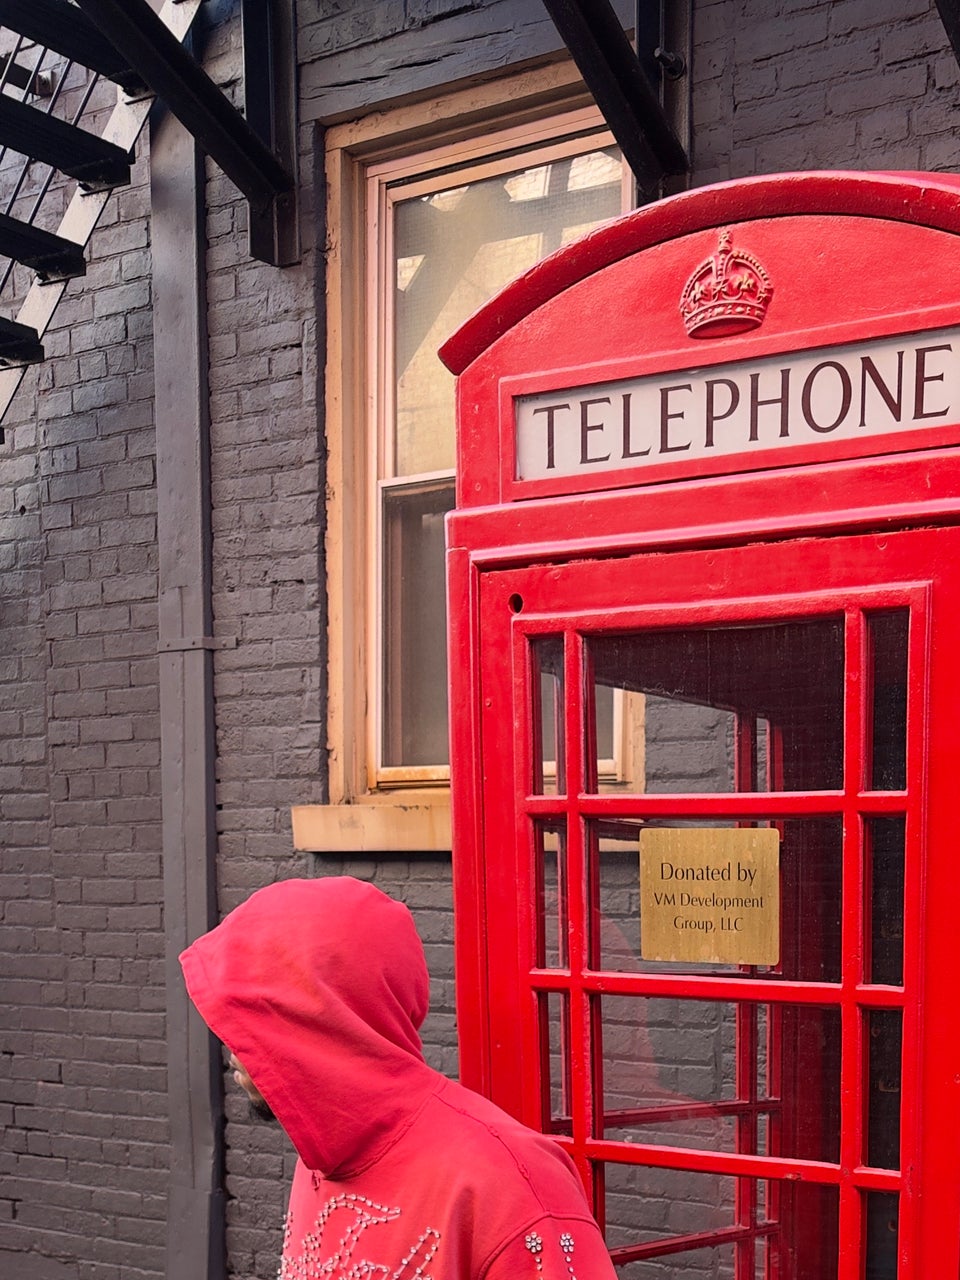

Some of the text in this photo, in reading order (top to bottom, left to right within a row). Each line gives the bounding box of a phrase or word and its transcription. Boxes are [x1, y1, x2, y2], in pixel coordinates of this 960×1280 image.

[532, 344, 953, 469] TELEPHONE
[661, 862, 757, 887] Donated by
[654, 892, 763, 910] VM Development
[673, 916, 744, 933] Group, LLC
